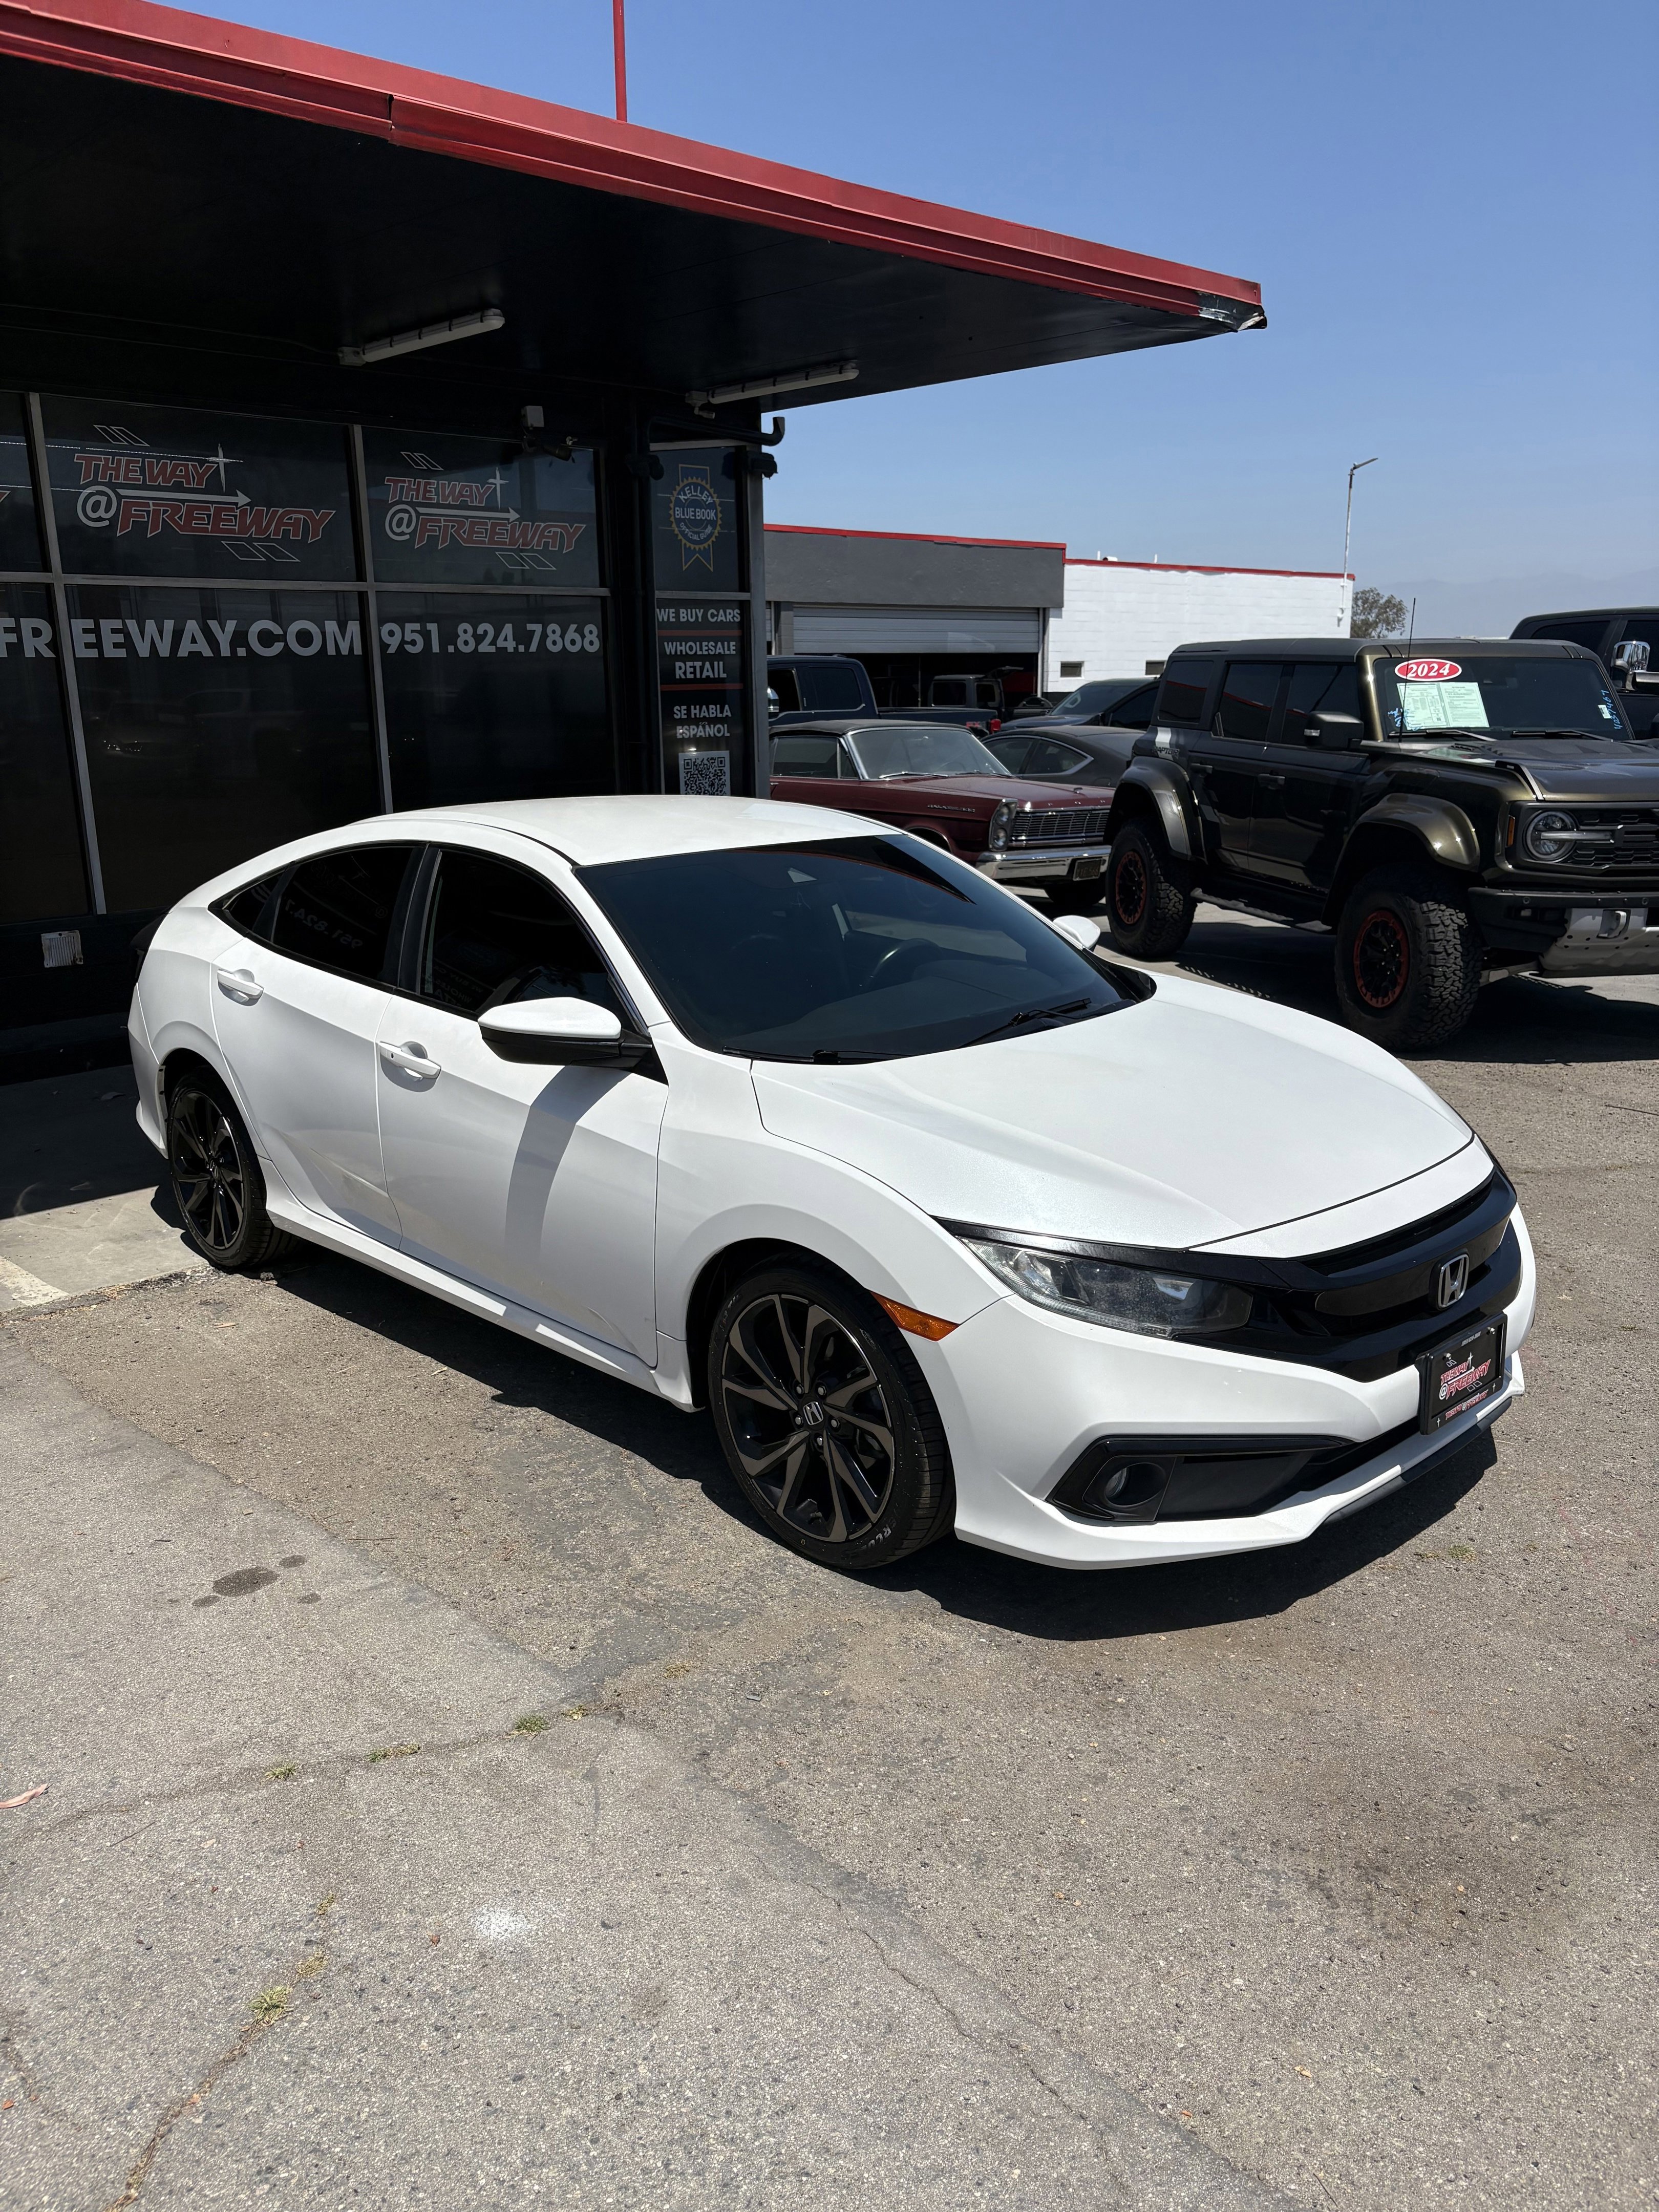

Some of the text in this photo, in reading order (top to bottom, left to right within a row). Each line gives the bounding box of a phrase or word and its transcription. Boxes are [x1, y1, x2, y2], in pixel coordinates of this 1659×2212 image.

[679, 485, 713, 504] KELLEY
[675, 507, 716, 520] BLUE BOOK
[656, 608, 740, 622] WE BUY CARS
[381, 622, 600, 654] 951.824.7868
[664, 642, 736, 655] WHOLESALE
[675, 662, 727, 679] RETAIL
[1407, 663, 1450, 677] 2024
[673, 705, 732, 719] SE HABLA
